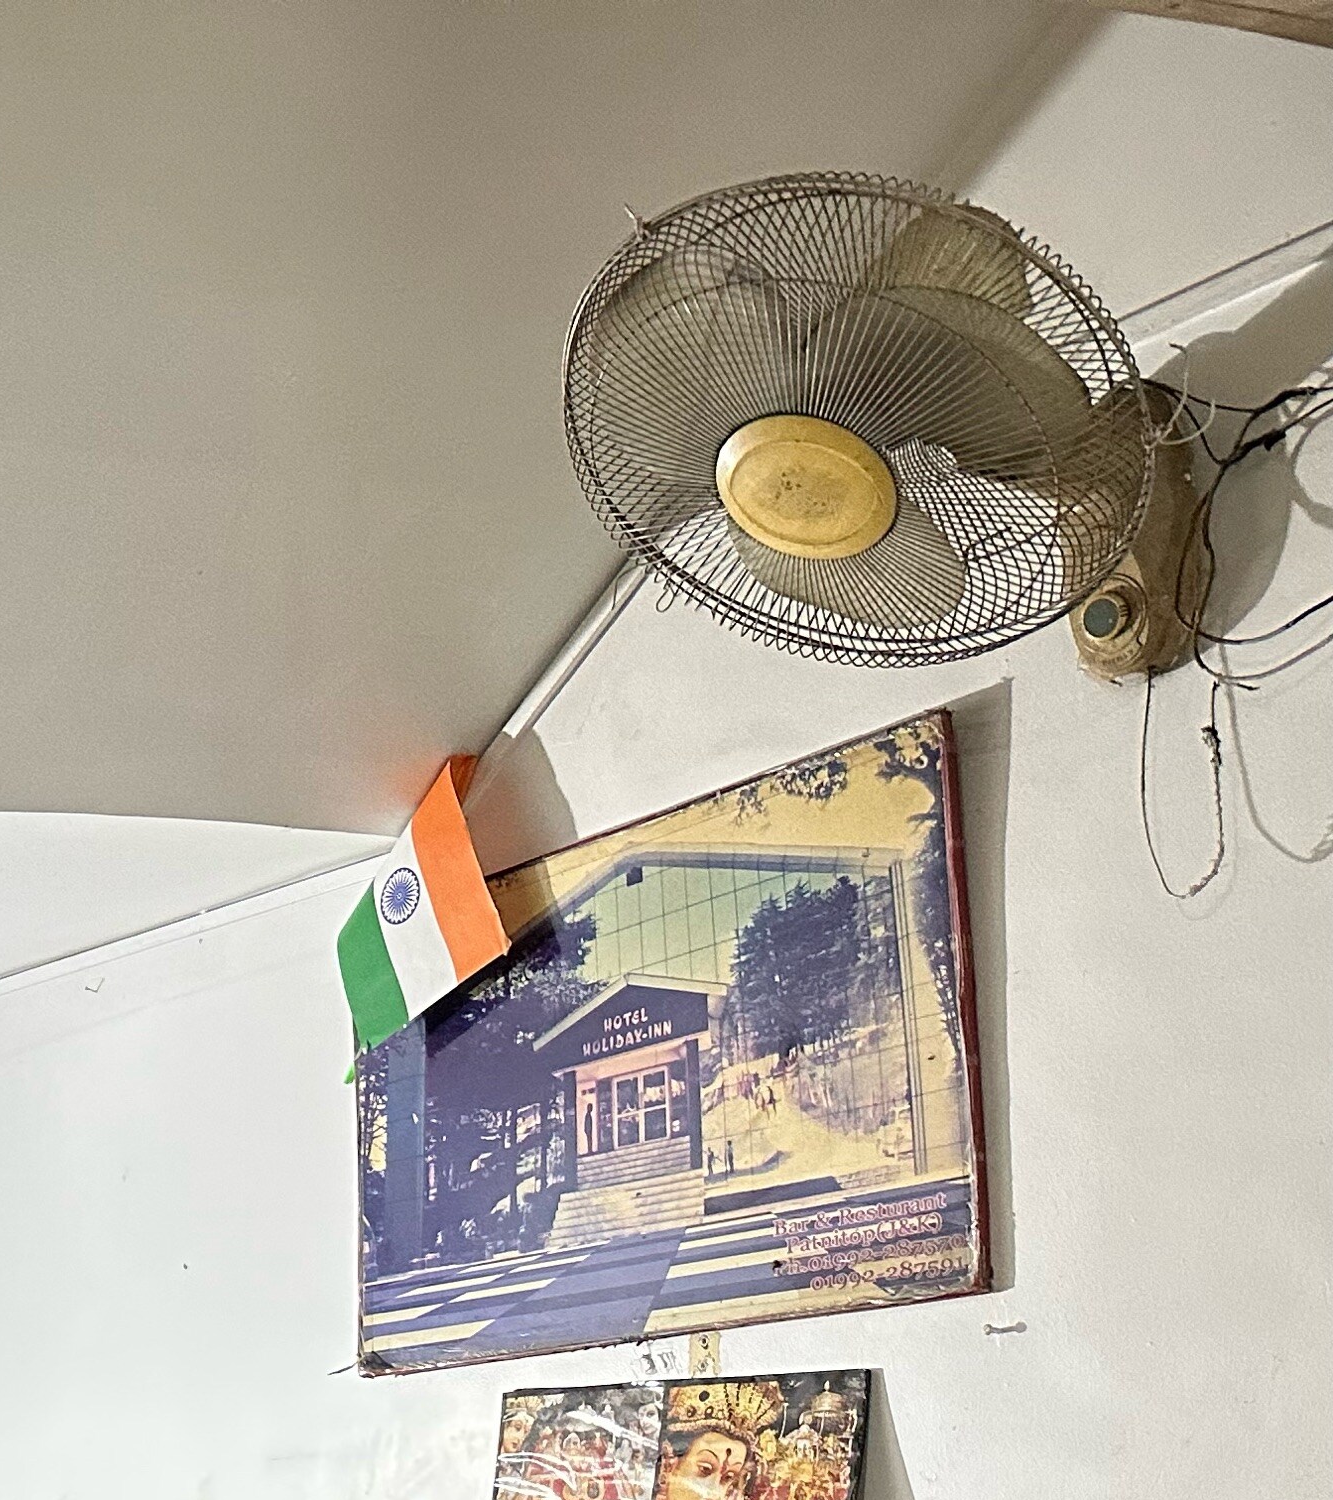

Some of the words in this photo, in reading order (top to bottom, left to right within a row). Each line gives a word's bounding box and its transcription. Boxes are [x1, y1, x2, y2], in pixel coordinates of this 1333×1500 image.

[603, 1008, 648, 1032] HOTEL
[583, 1020, 672, 1056] HOLIDAY-INN
[773, 1218, 810, 1237] Bar
[814, 1211, 833, 1229] &
